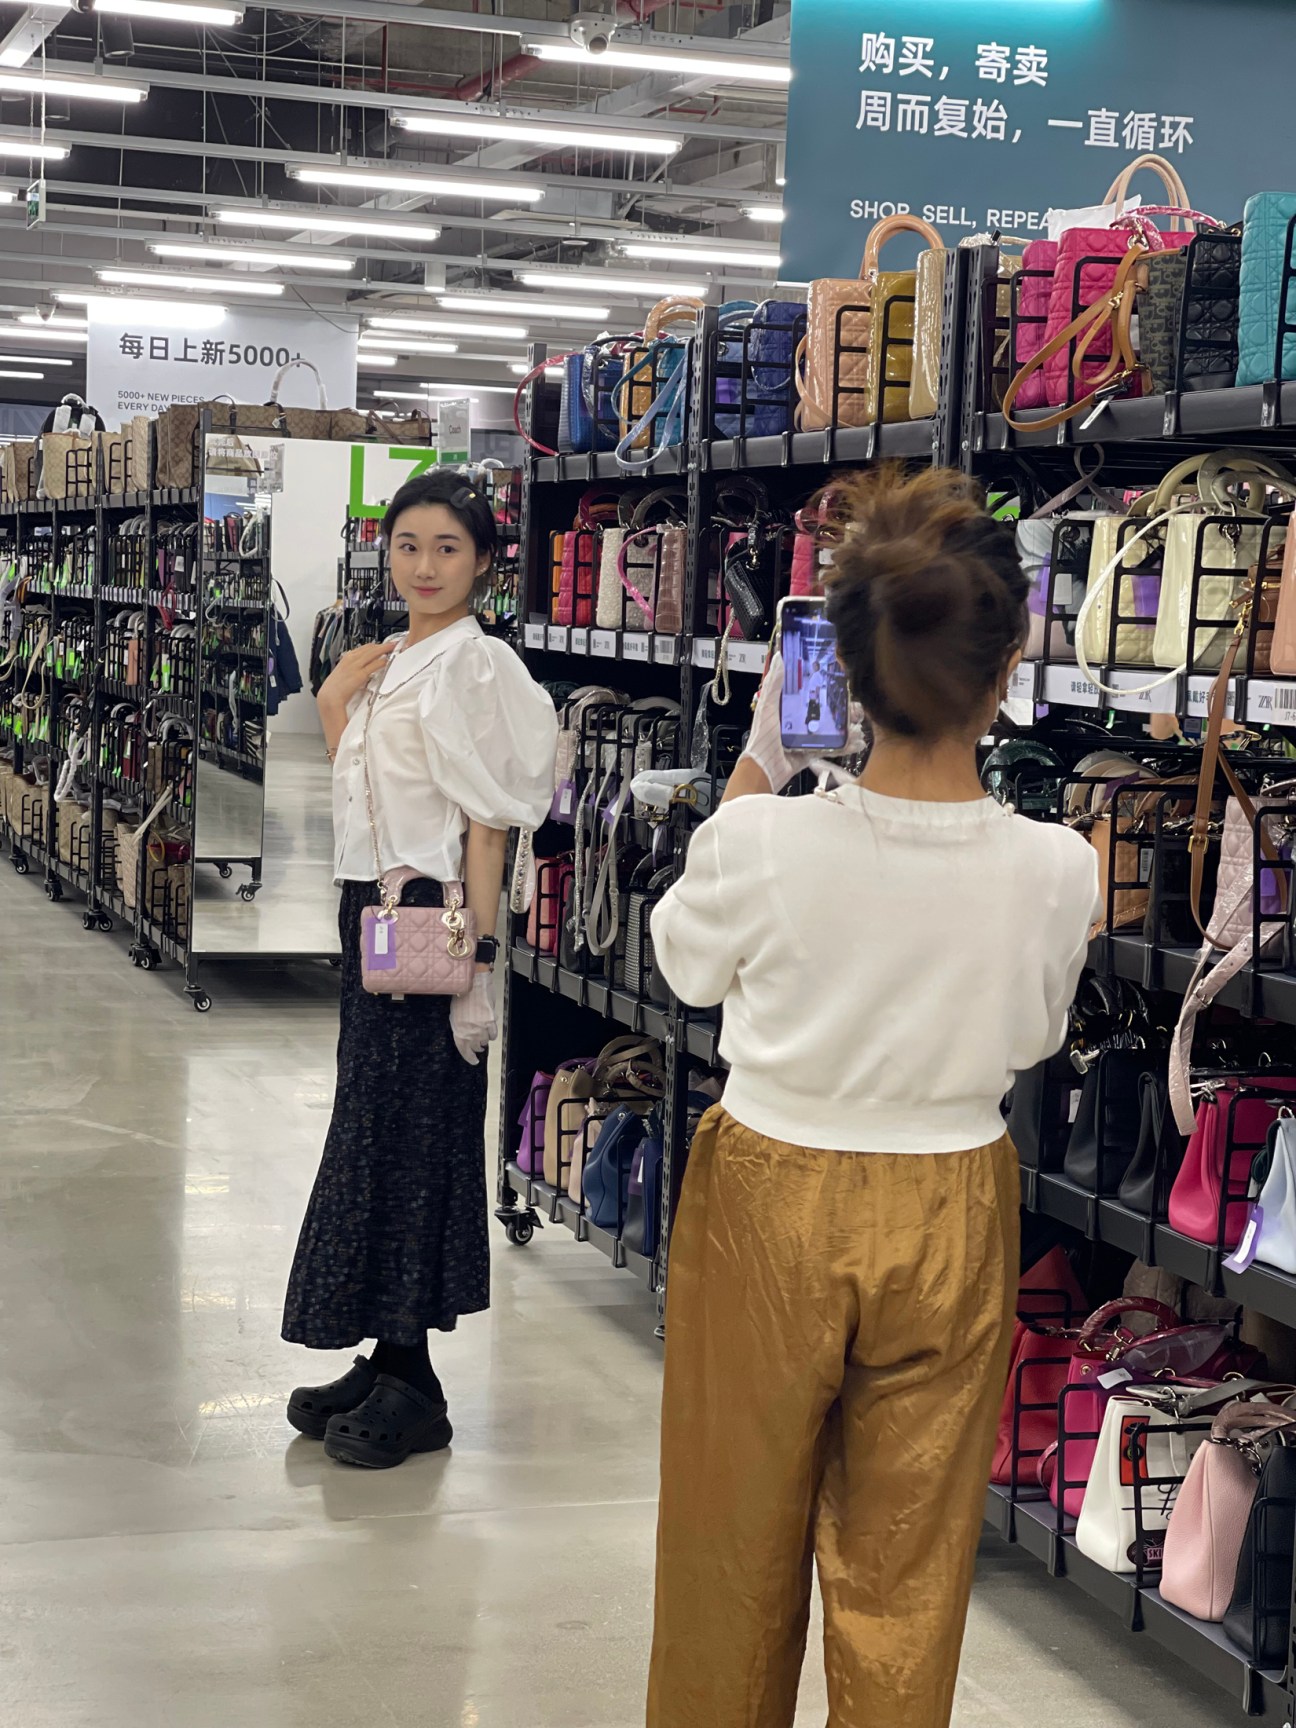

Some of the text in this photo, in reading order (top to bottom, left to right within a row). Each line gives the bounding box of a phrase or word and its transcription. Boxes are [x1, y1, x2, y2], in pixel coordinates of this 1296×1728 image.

[855, 90, 1195, 153] 周而复始，一直循环
[922, 204, 977, 228] SELL,
[117, 390, 145, 400] 5000+
[147, 392, 169, 402] NEW
[117, 401, 149, 411] EVERY
